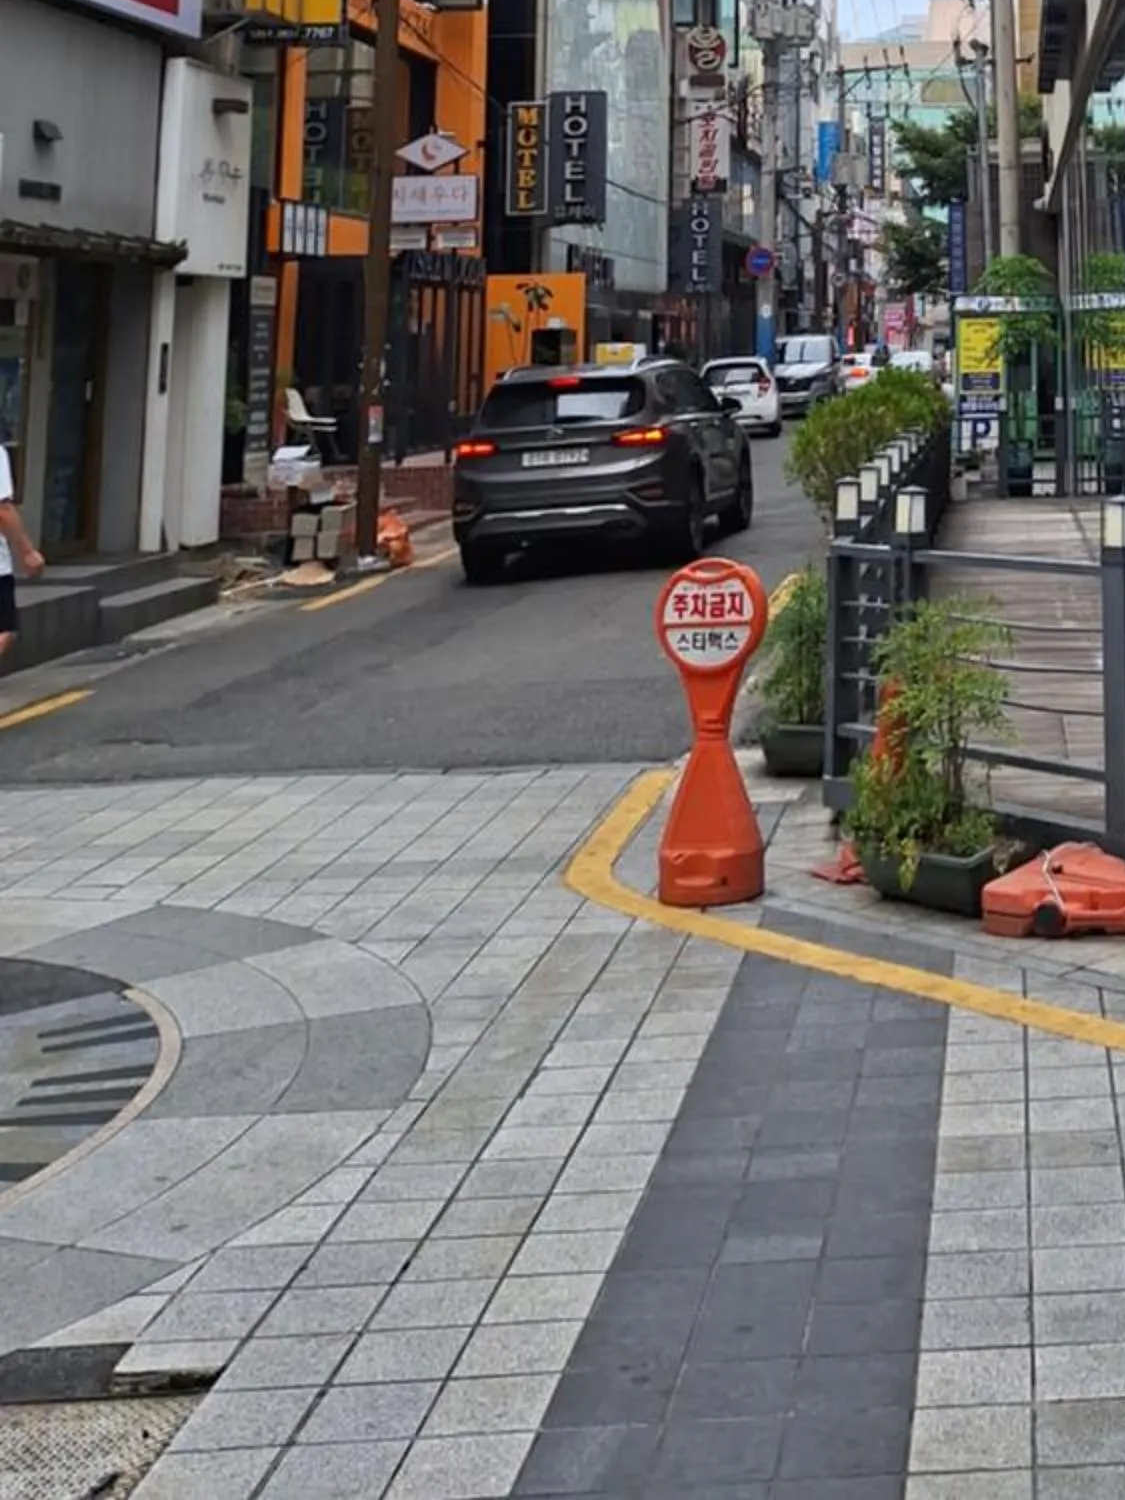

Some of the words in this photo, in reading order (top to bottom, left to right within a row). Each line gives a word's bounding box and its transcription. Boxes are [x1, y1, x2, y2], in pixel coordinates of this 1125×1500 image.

[517, 106, 539, 209] MOTEL
[562, 95, 588, 202] HOTEL
[690, 201, 710, 282] HOTEL
[673, 591, 745, 620] 주차금지
[676, 631, 739, 652] 스타벅스
